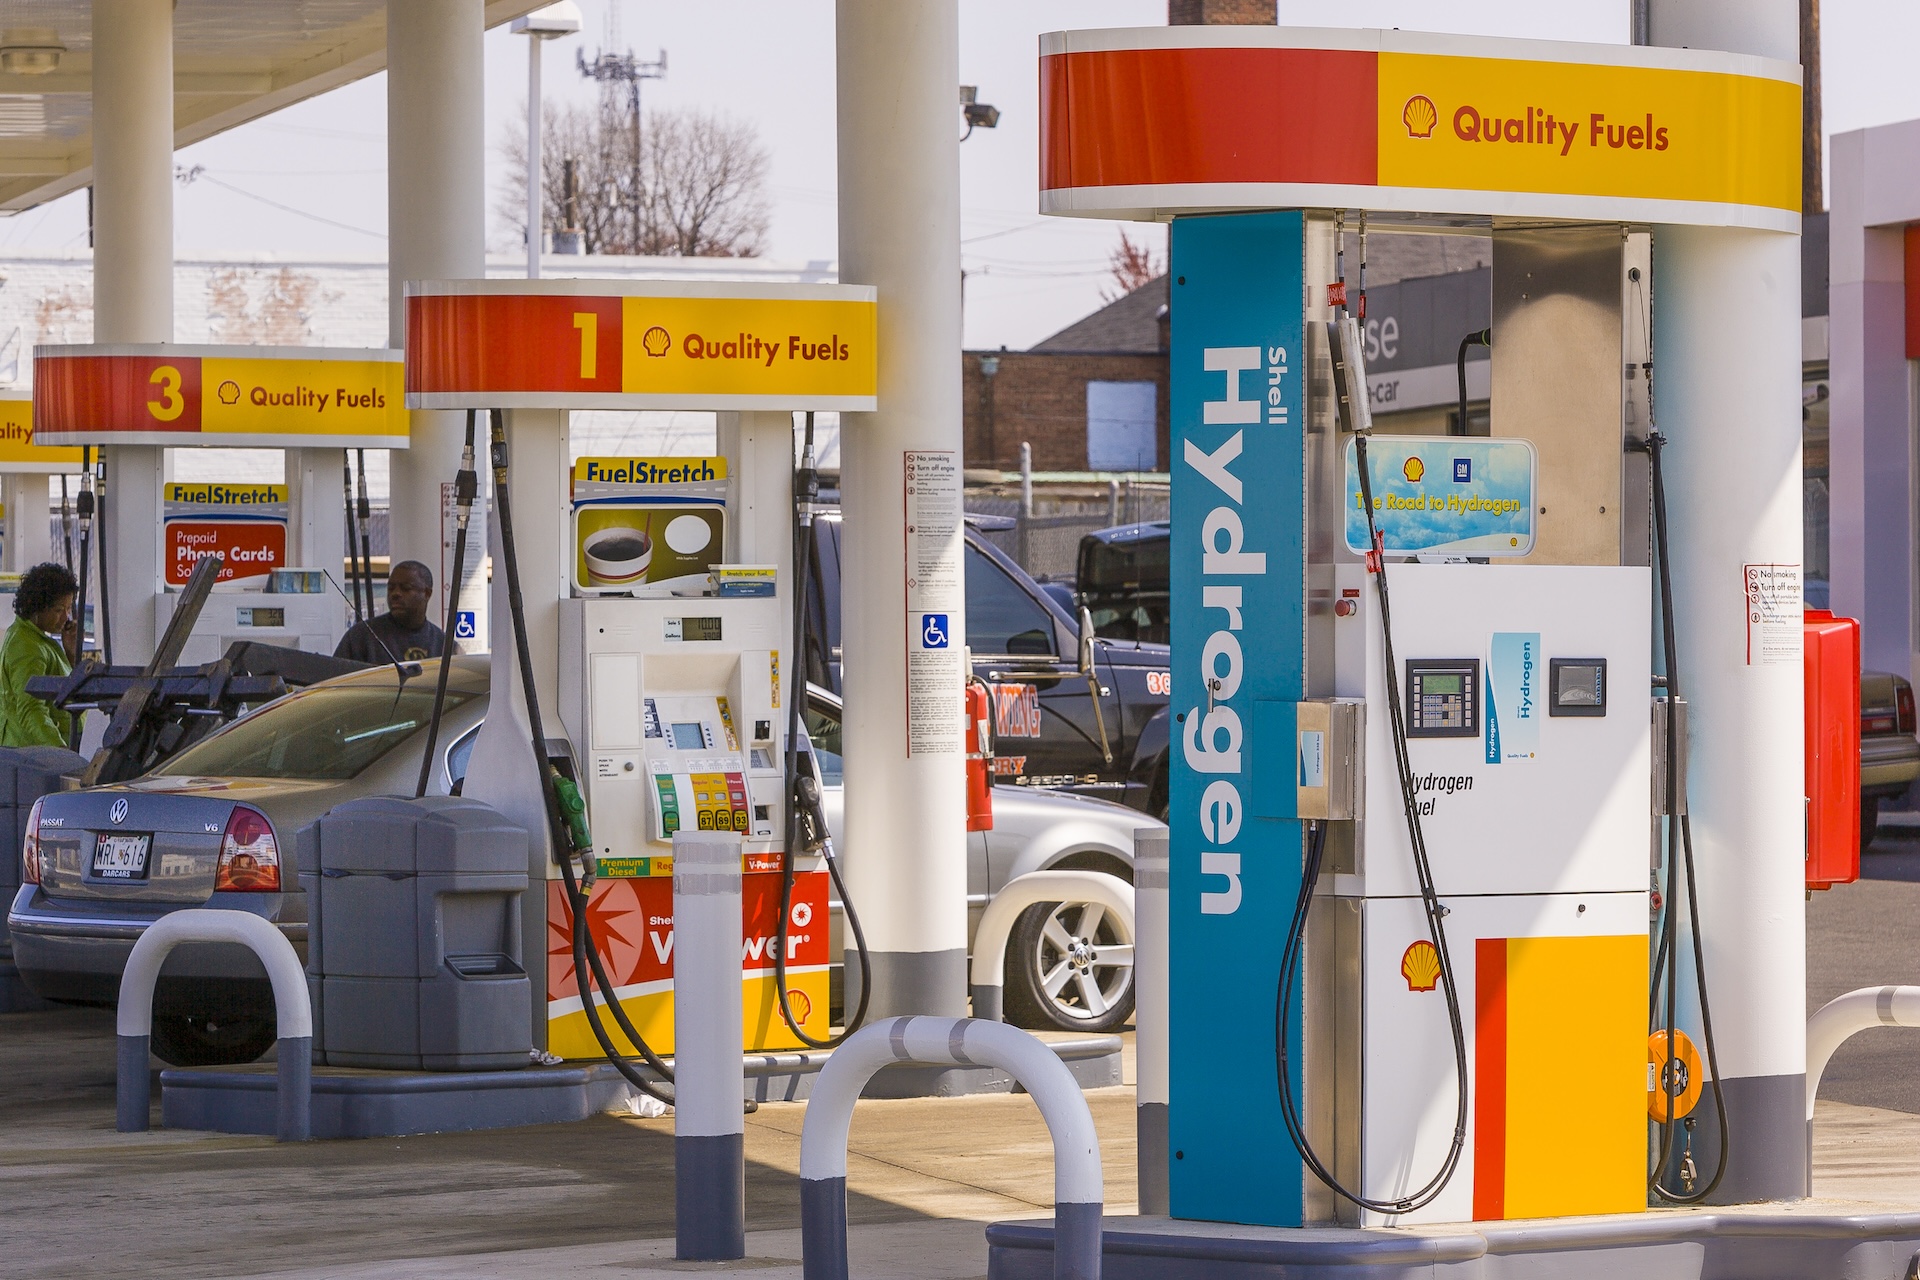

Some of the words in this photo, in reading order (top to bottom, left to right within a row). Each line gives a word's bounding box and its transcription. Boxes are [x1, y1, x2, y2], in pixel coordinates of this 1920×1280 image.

[1452, 104, 1580, 156] Quality
[1589, 111, 1670, 152] Fuels
[573, 312, 598, 379] 1
[682, 332, 781, 367] Quality
[788, 335, 849, 361] Fuels
[147, 365, 184, 422] 3
[1268, 346, 1288, 425] Shell
[250, 386, 330, 413] Quality
[336, 388, 386, 409] Fuels
[0, 421, 34, 445] ality
[928, 455, 950, 463] smoking
[587, 459, 715, 484] FuelStretch
[940, 465, 955, 473] engine
[1456, 464, 1468, 474] GM
[173, 485, 279, 504] FuelStretch
[1355, 492, 1382, 509] Te
[1387, 493, 1425, 510] Road
[1429, 495, 1443, 511] to
[1447, 494, 1520, 515] Hydrogen
[176, 530, 217, 546] Prepaid
[230, 545, 275, 562] Cards
[176, 564, 196, 578] Sol
[216, 567, 234, 578] ere
[1760, 570, 1772, 579] No
[1773, 570, 1797, 580] smoking
[1761, 583, 1776, 591] Turn
[1777, 583, 1786, 591] off
[1183, 346, 1267, 915] Hydrogen
[1520, 641, 1533, 719] Hydrogen
[1489, 718, 1497, 758] Hydrogen
[1405, 797, 1436, 816] uel
[40, 818, 65, 827] PASSAT
[204, 823, 219, 832] V6
[701, 816, 711, 826] 87
[718, 816, 729, 825] 89
[735, 816, 747, 825] 93
[123, 844, 144, 866] 616
[600, 857, 644, 867] Premium
[608, 867, 637, 876] Diesel
[749, 860, 780, 870] V-Power
[102, 870, 131, 878] DARCARS
[649, 916, 674, 926] Shel
